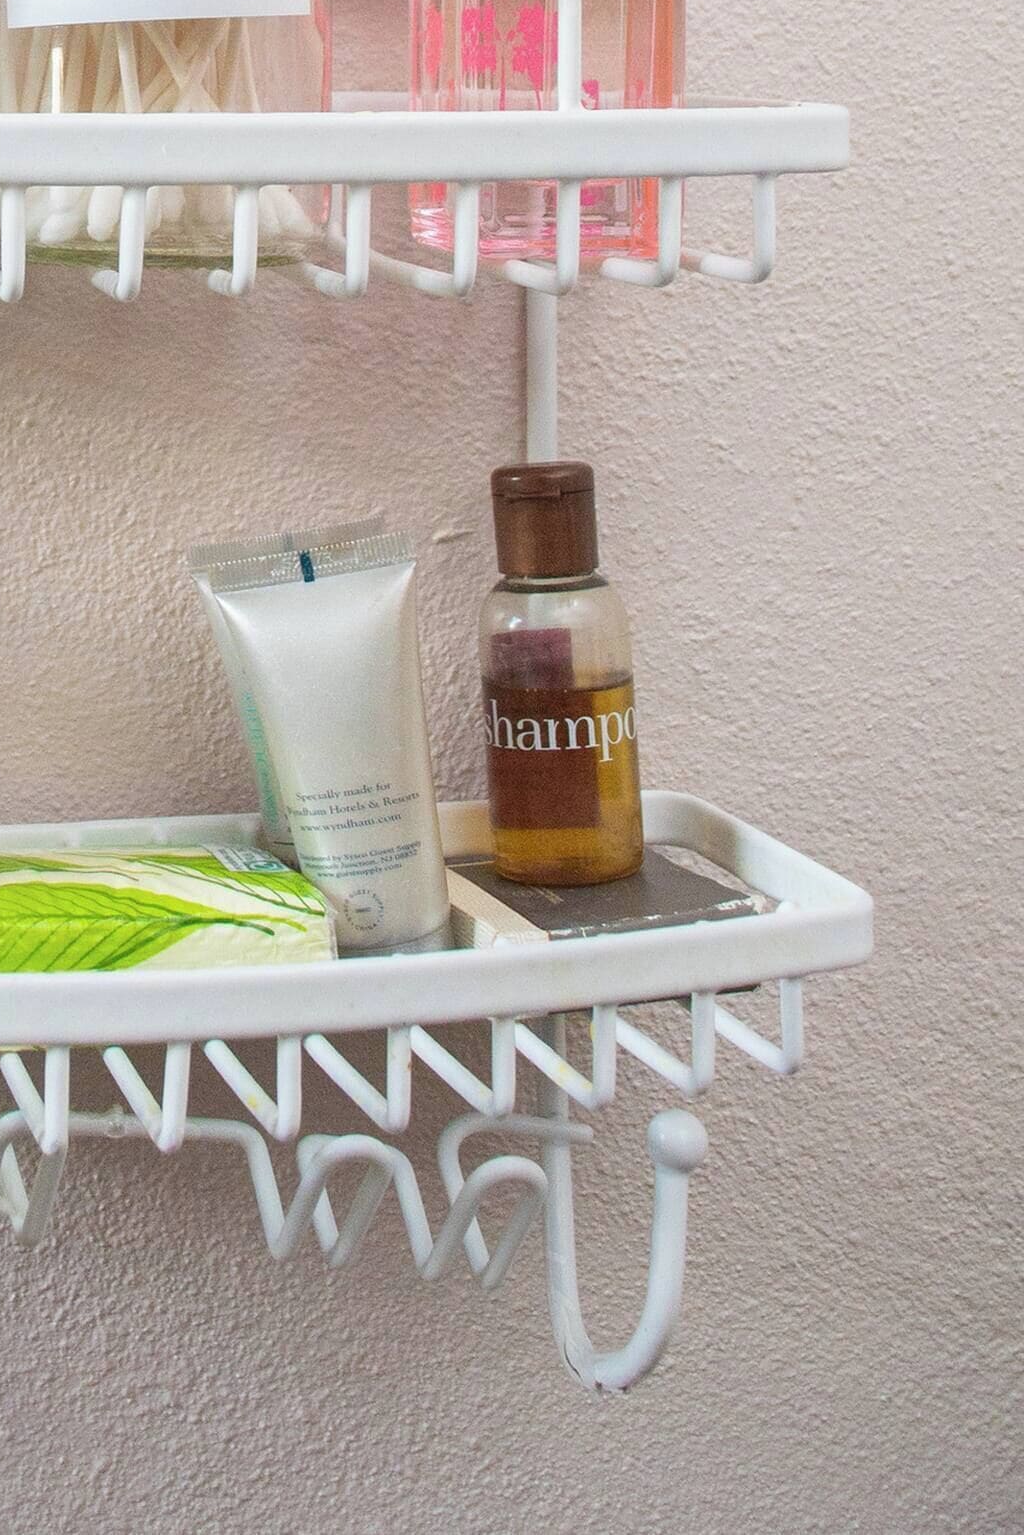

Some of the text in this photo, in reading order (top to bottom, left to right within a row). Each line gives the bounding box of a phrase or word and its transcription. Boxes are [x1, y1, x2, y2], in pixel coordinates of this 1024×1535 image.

[296, 782, 391, 803] Specially made for
[329, 801, 366, 815] Hotels
[368, 799, 379, 809] &
[383, 792, 419, 807] Resorts
